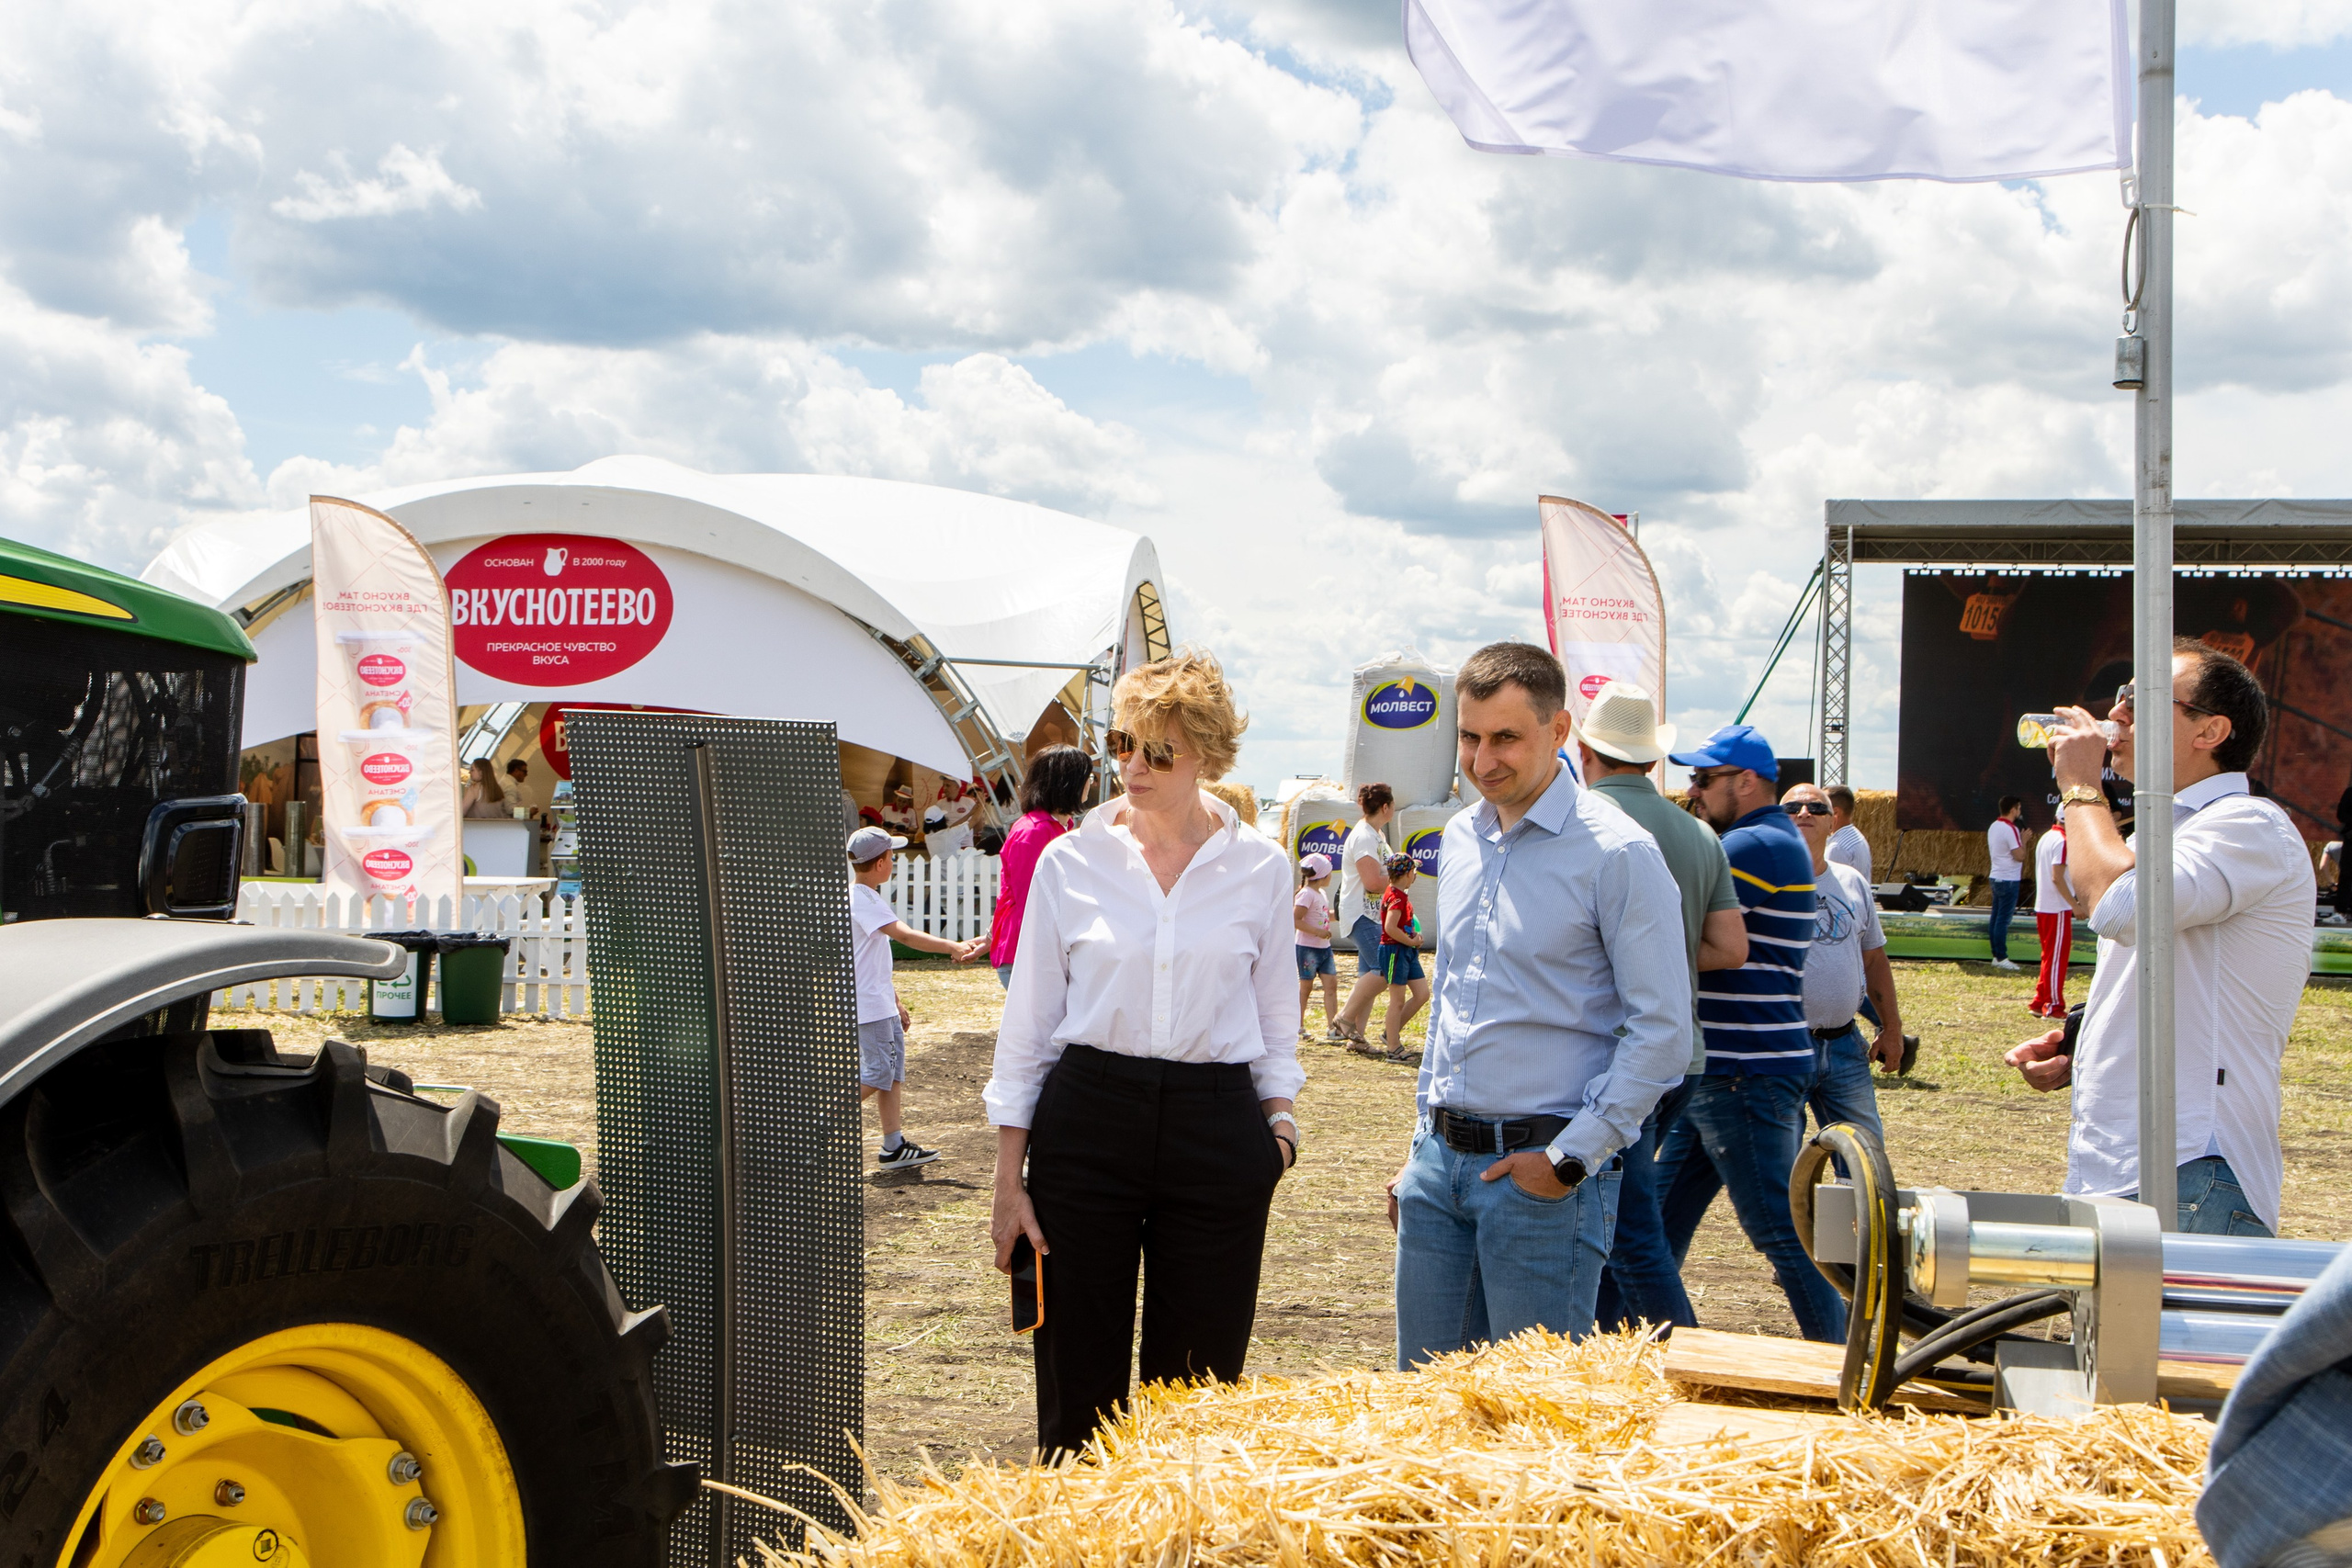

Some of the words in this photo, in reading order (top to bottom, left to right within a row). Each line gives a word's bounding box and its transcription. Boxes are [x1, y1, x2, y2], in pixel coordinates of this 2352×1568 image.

[484, 558, 534, 568] ОСНОВАН
[572, 558, 580, 567] В
[582, 558, 604, 567] 2000
[605, 559, 627, 568] году
[452, 587, 656, 626] ВКУСНОТЕЕВО
[486, 641, 561, 652] ПРЕКРАСНОЕ
[563, 641, 616, 652] ЧУВСТВО
[532, 655, 570, 665] ВКУСА
[1370, 700, 1433, 714] МОЛВЕСТ
[1301, 841, 1344, 855] МОЛВЕ
[376, 990, 412, 999] ПРОЧЕЕ
[189, 1222, 475, 1293] TRELLEBORG
